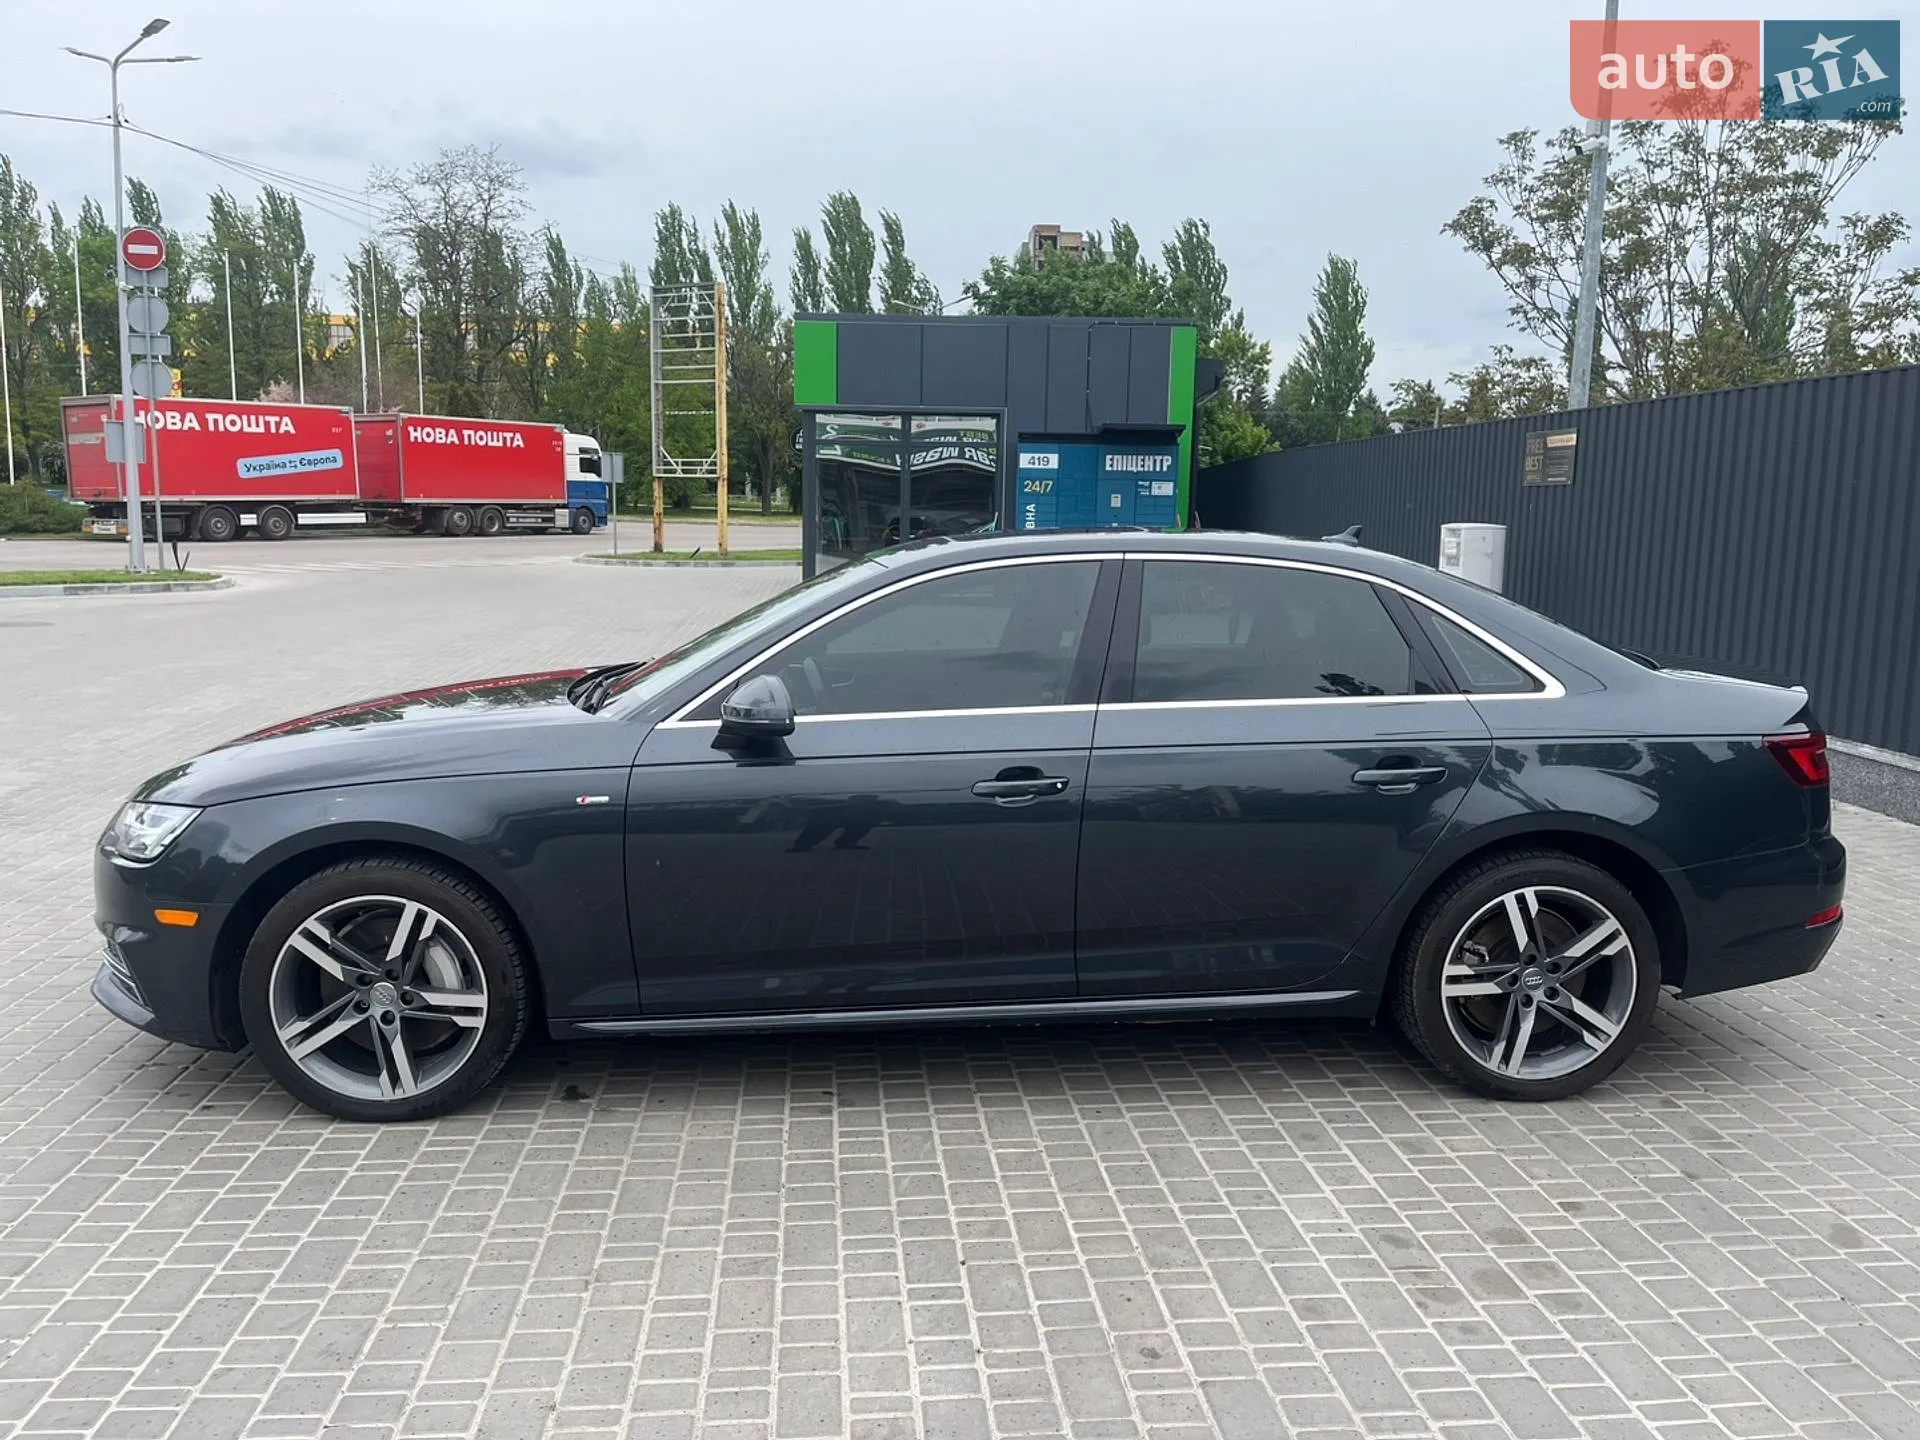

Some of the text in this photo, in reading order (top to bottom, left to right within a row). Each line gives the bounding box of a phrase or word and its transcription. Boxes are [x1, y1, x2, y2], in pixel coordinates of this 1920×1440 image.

[205, 412, 296, 435] ПОШТА
[407, 426, 525, 448] НОВА ПОШТА
[244, 455, 338, 474] Україна Європа
[1028, 455, 1050, 466] 419
[1105, 454, 1172, 473] ЕПІЦЕНТР
[1023, 480, 1053, 494] 24/7
